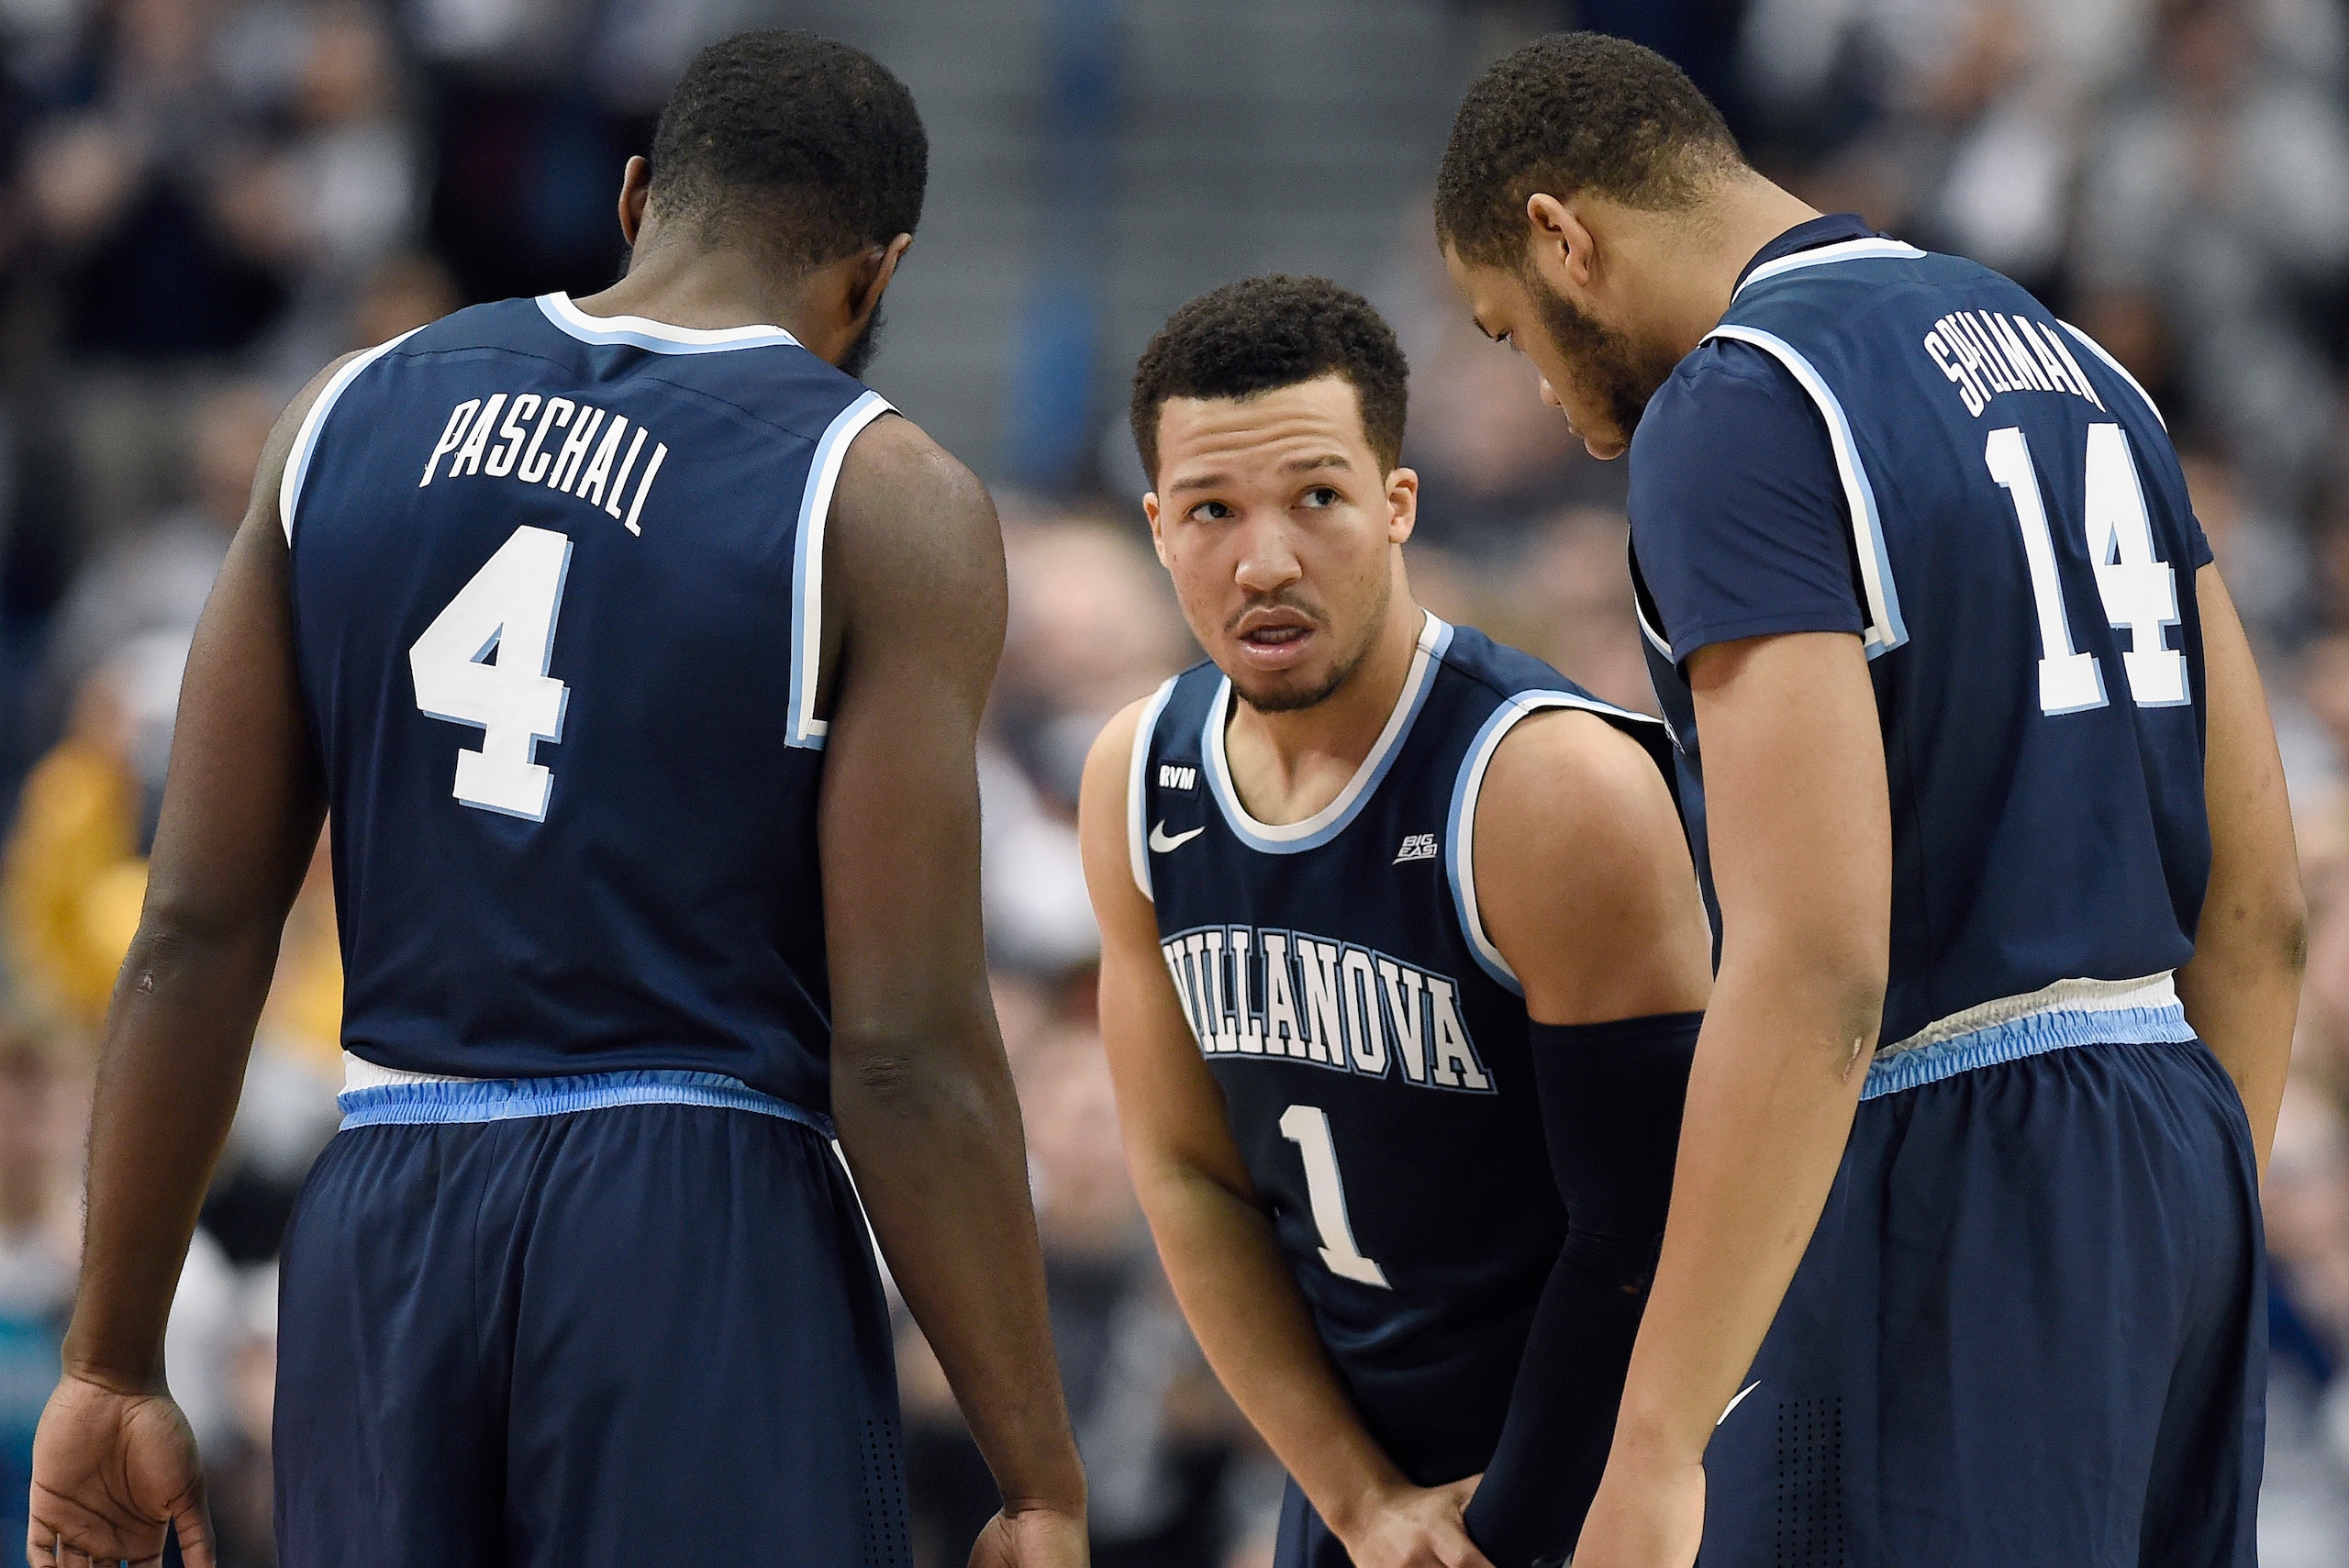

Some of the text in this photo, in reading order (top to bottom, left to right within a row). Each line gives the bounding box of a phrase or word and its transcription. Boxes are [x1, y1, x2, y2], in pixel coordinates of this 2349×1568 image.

[1923, 309, 2107, 418] SPELLMAN
[419, 393, 668, 538] PASCHALL
[1985, 422, 2192, 717] 14
[409, 525, 573, 823] 4
[1159, 764, 1197, 791] RVM
[1397, 842, 1438, 857] EAST
[1402, 833, 1434, 846] BIG
[1160, 924, 1498, 1095] VILLANOVA
[1279, 1104, 1394, 1290] 1
